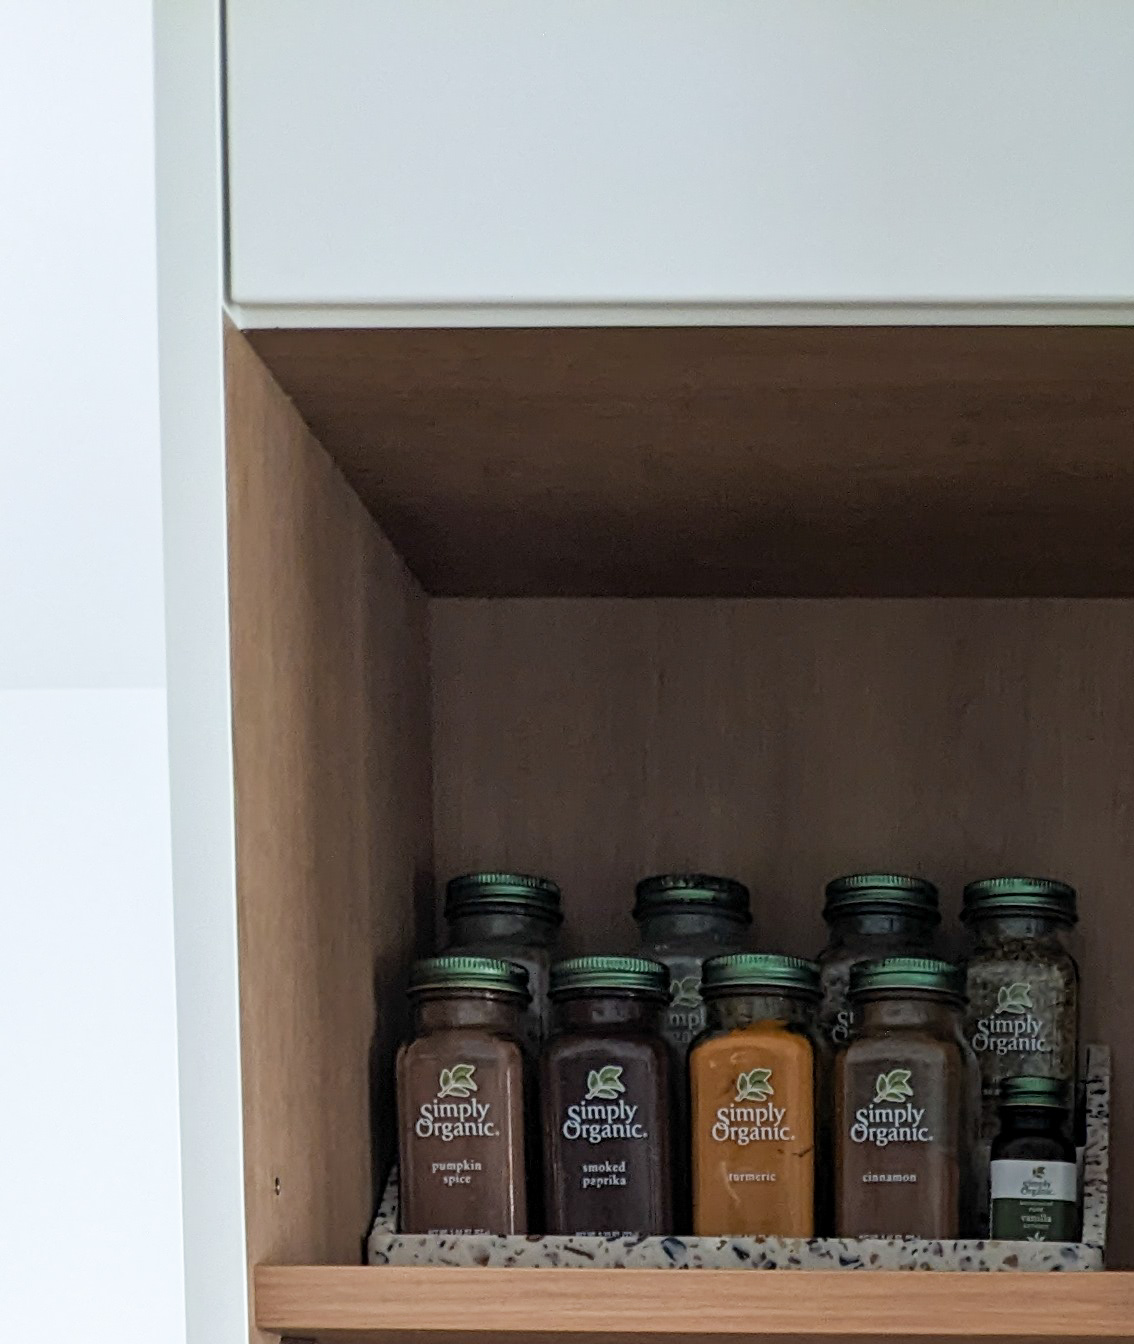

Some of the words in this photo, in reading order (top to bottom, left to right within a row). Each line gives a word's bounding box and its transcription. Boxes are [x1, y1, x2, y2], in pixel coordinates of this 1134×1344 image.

[977, 1014, 1043, 1037] Simply
[420, 1098, 490, 1124] Simply
[567, 1100, 638, 1124] Simply
[717, 1102, 786, 1127] Simply
[856, 1102, 925, 1127] Simply
[432, 1159, 482, 1172] pumpkin
[582, 1161, 626, 1172] smoked
[443, 1173, 471, 1185] spice
[582, 1175, 626, 1188] paprika
[728, 1172, 776, 1182] turmeric
[862, 1171, 917, 1182] cinnamon
